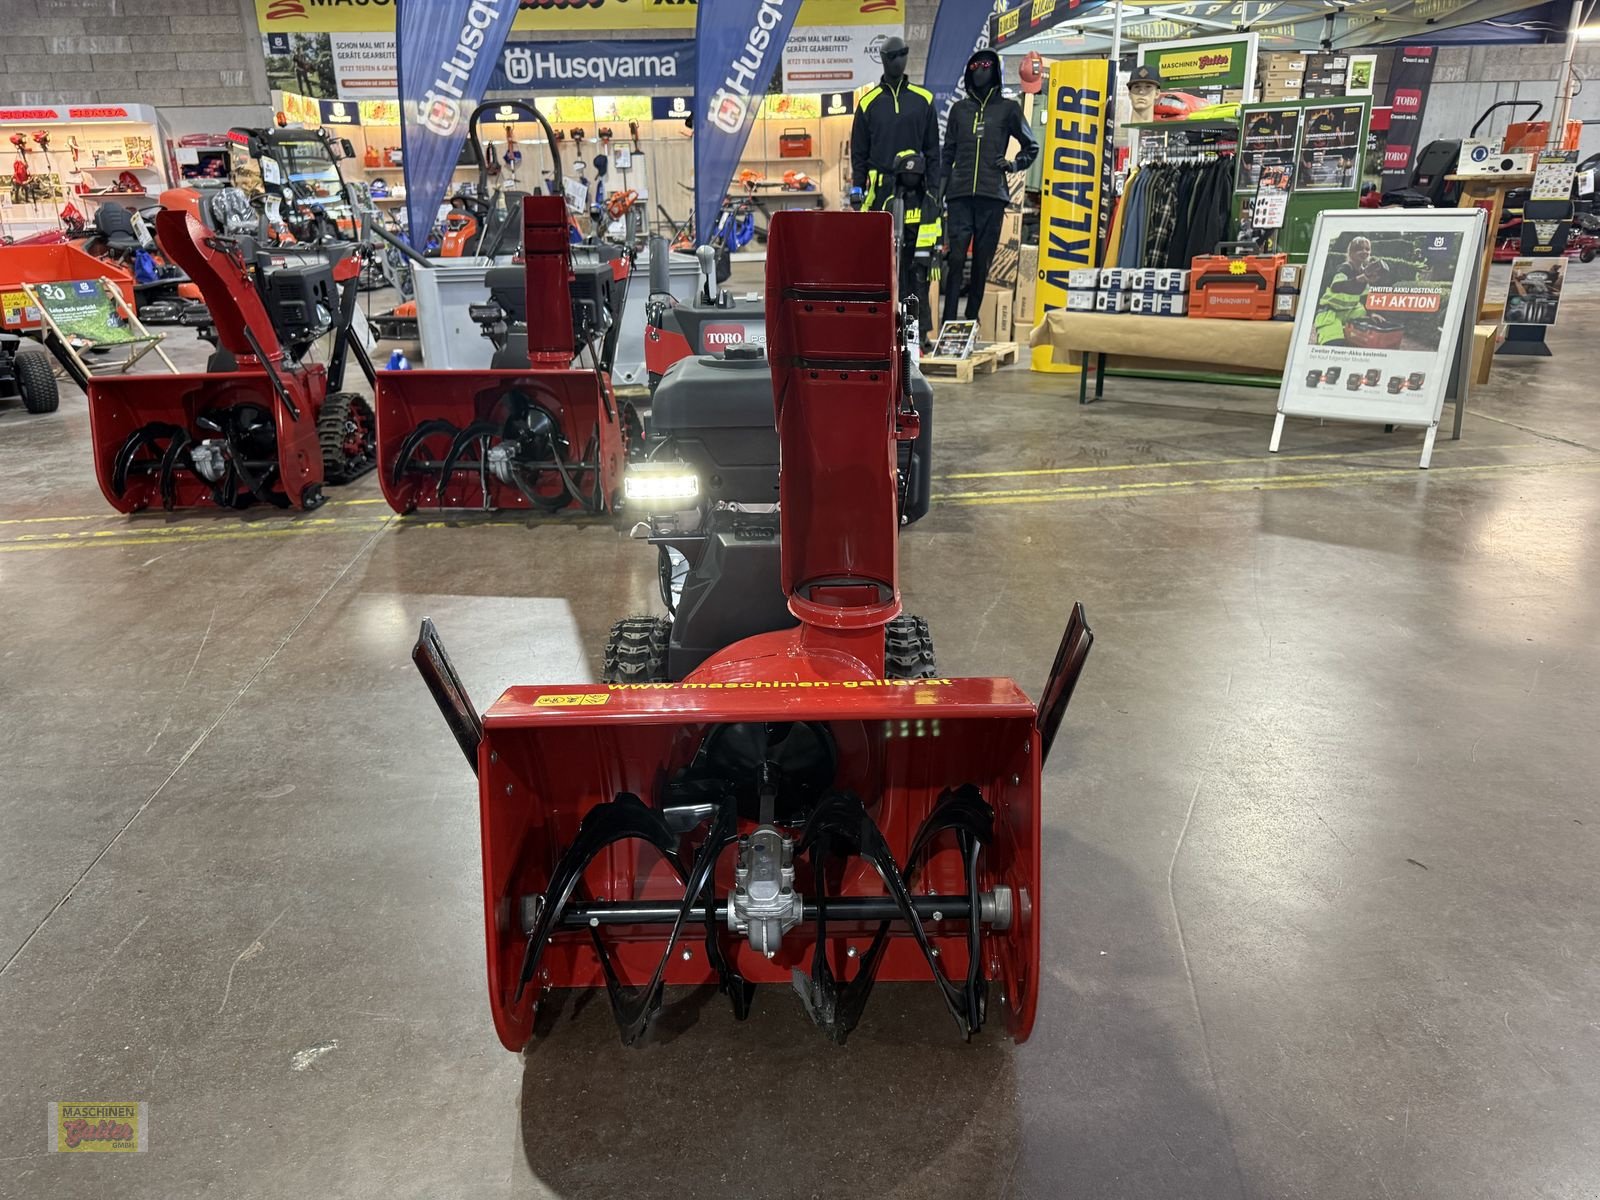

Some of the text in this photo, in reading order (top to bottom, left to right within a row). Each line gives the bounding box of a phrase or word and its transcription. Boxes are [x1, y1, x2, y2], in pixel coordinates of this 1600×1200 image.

[434, 0, 499, 98] Husq
[725, 0, 784, 97] Husq
[337, 51, 362, 60] GERÄTE
[534, 52, 677, 82] Husqvarna
[1161, 60, 1198, 70] MASCHINEN
[1395, 96, 1418, 106] TORO
[0, 110, 58, 120] HONDA
[68, 108, 128, 118] HONDA
[1384, 150, 1408, 161] TORO
[1098, 118, 1114, 239] WORKWEAR
[1370, 294, 1436, 308] 1+1 AKTION
[707, 332, 742, 344] TORO
